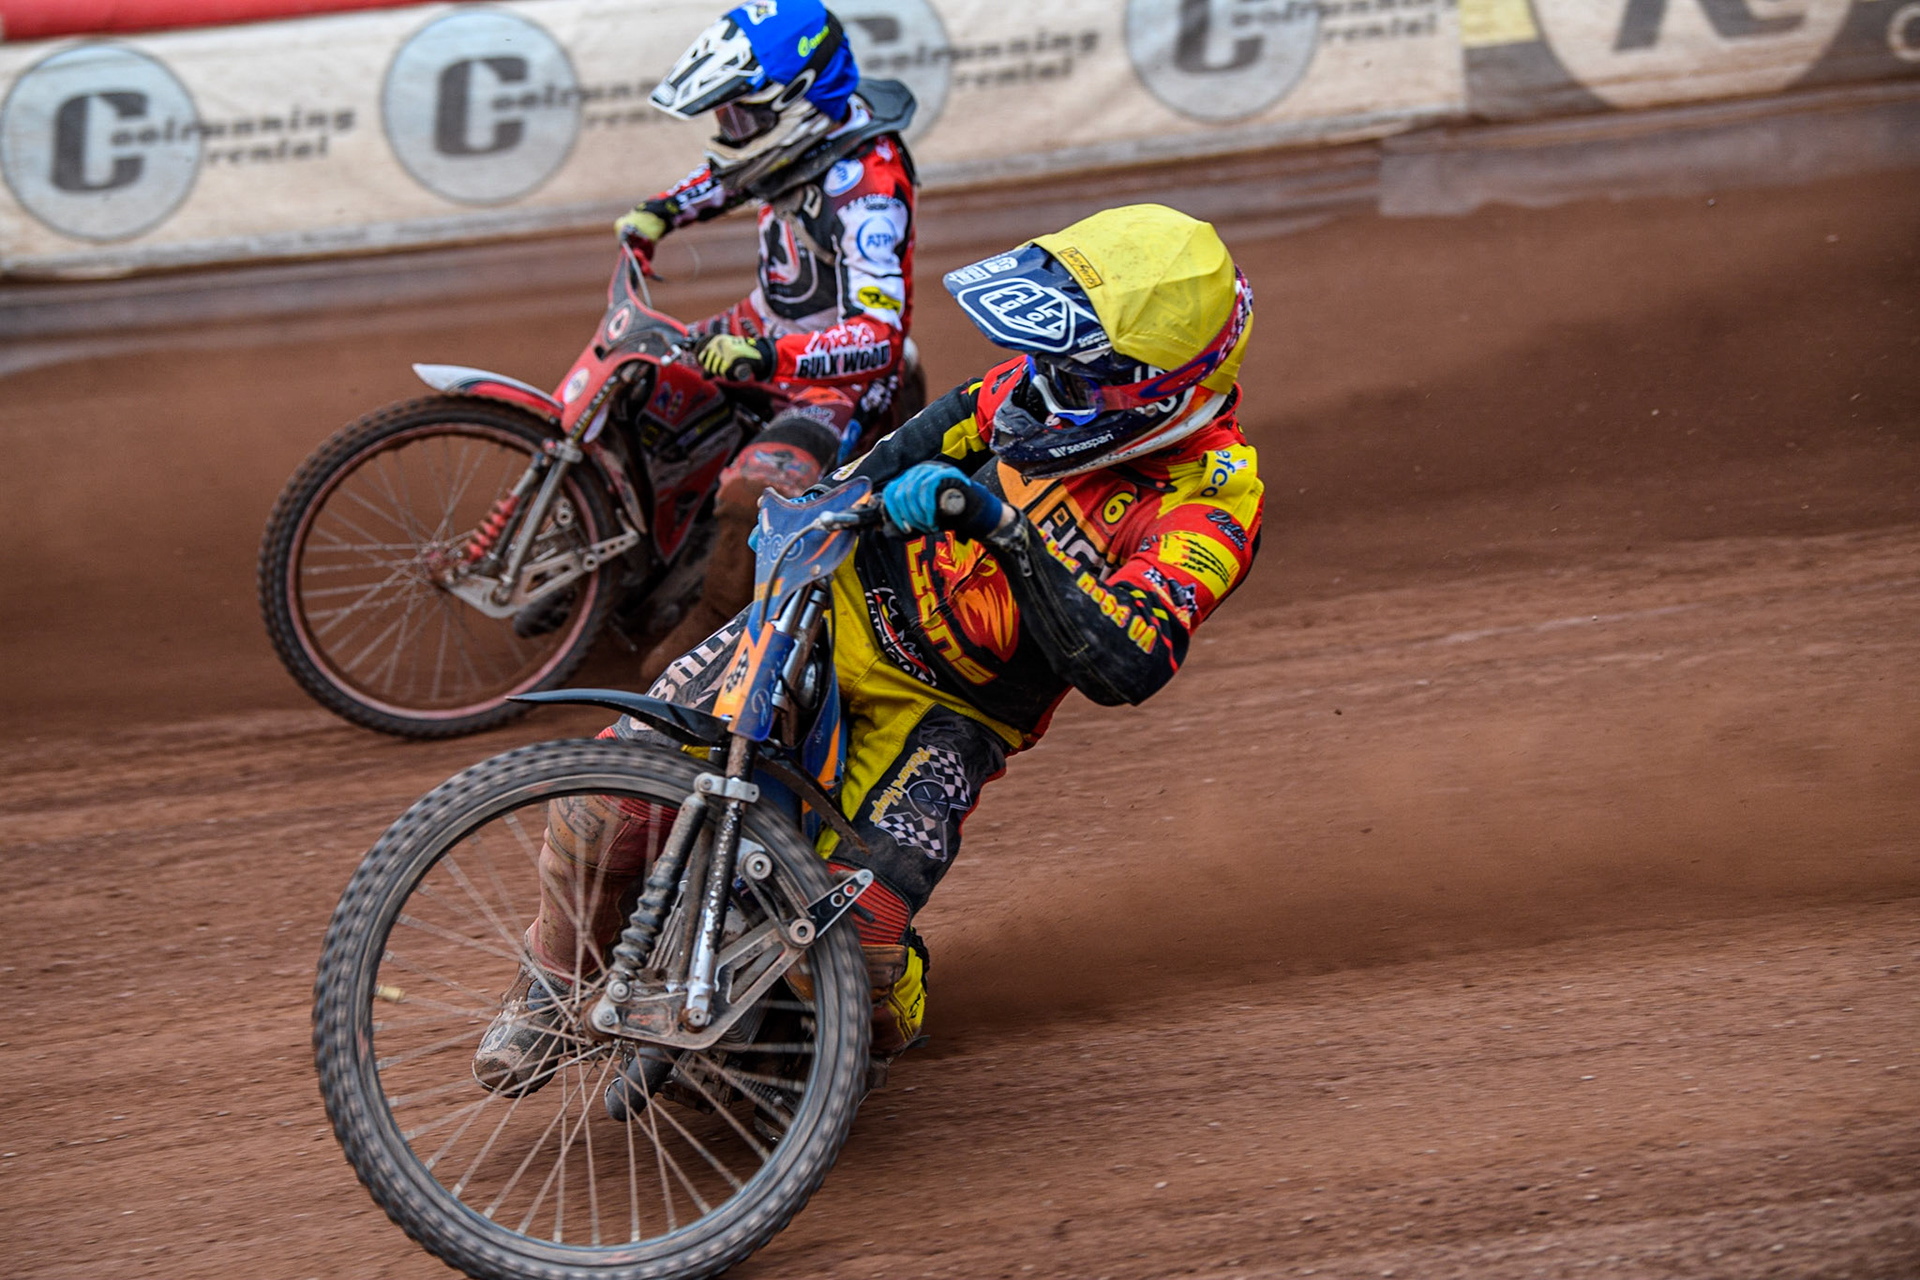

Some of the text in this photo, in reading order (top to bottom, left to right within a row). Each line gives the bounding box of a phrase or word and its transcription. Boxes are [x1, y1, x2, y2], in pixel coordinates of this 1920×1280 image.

[1066, 431, 1115, 455] seaspan
[1200, 449, 1236, 498] efco
[1103, 491, 1136, 525] 6
[868, 786, 904, 825] Hayes
